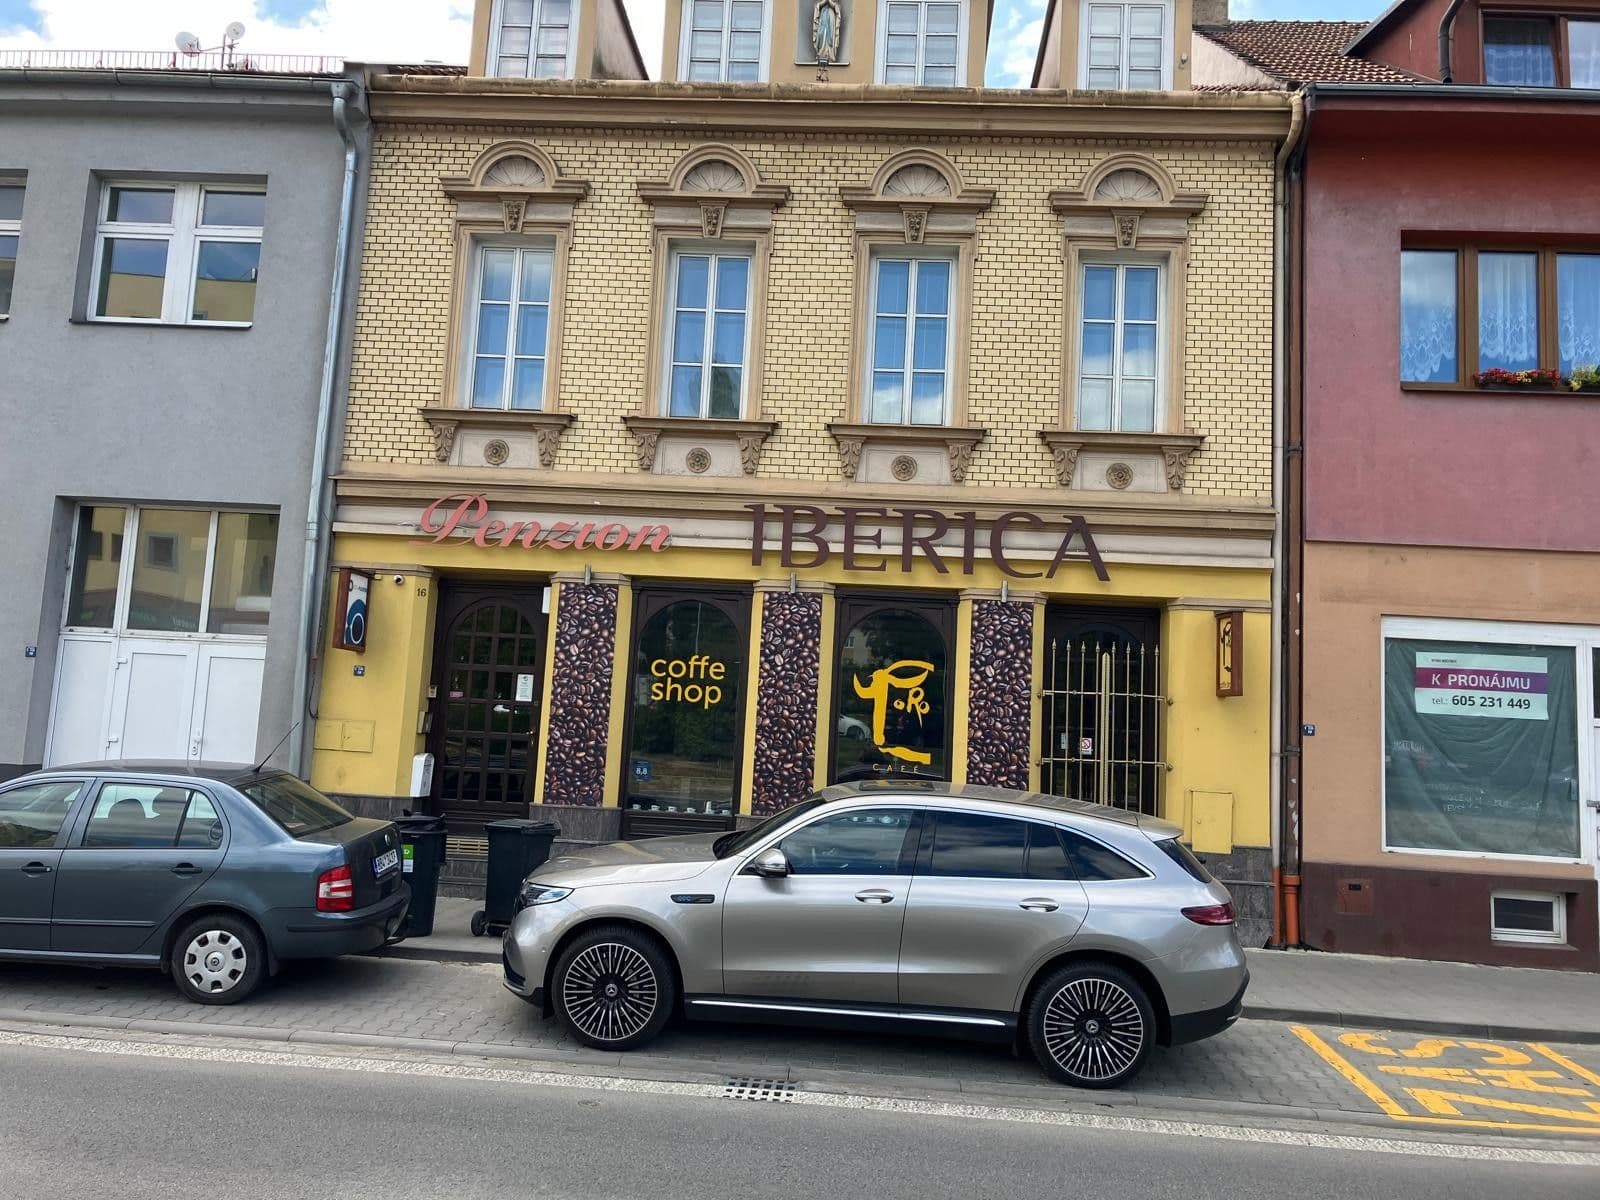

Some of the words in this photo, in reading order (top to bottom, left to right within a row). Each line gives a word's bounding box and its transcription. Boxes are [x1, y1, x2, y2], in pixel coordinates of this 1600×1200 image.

[408, 492, 671, 552] Penzion
[743, 503, 1110, 582] IBERICA
[417, 587, 426, 597] 16
[650, 655, 726, 680] coffe
[1431, 673, 1441, 686] K
[1448, 673, 1531, 690] PRONÁJMU
[650, 678, 722, 709] shop
[1452, 695, 1476, 706] 605
[1480, 697, 1503, 708] 231
[1507, 698, 1531, 710] 449
